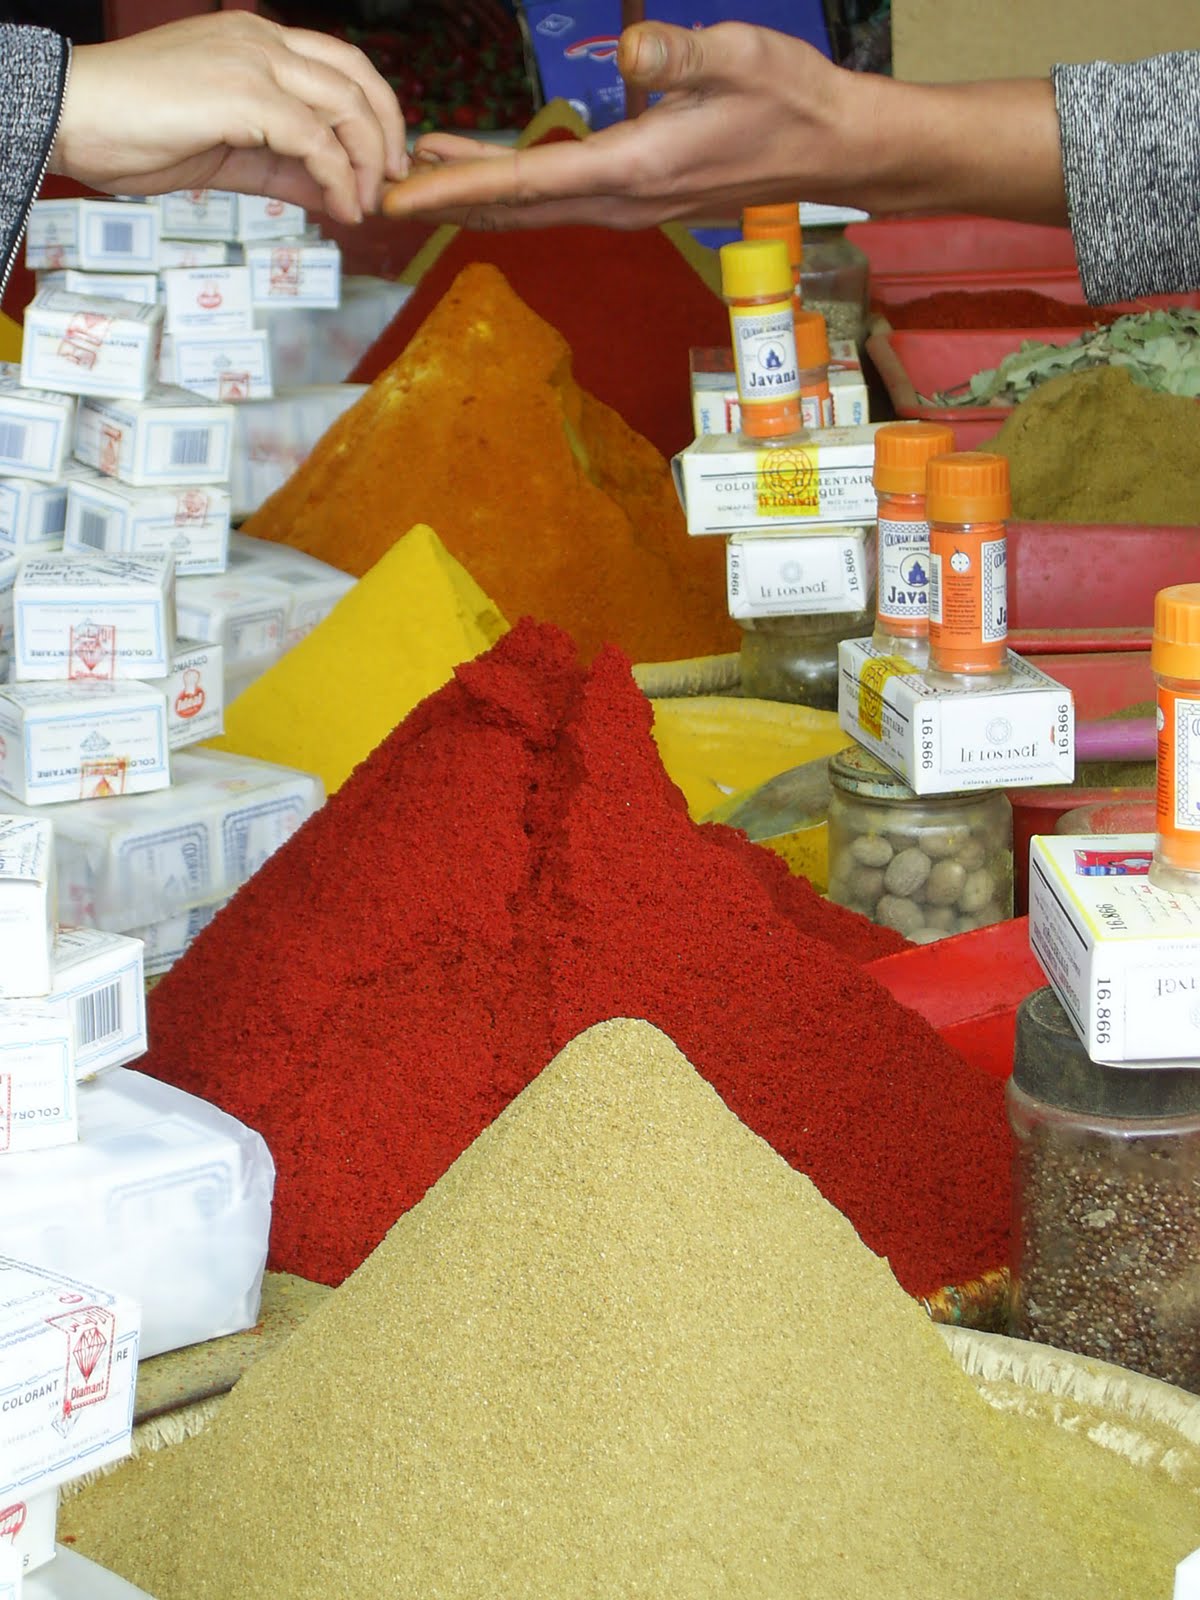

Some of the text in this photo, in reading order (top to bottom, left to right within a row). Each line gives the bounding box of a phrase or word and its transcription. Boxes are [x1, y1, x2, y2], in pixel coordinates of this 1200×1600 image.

[749, 370, 797, 388] Javana
[921, 718, 934, 770] 16.866
[1058, 704, 1069, 756] 16.866
[1096, 977, 1112, 1045] 16.866
[2, 1379, 60, 1413] COLORANT
[70, 1377, 105, 1401] Diamant
